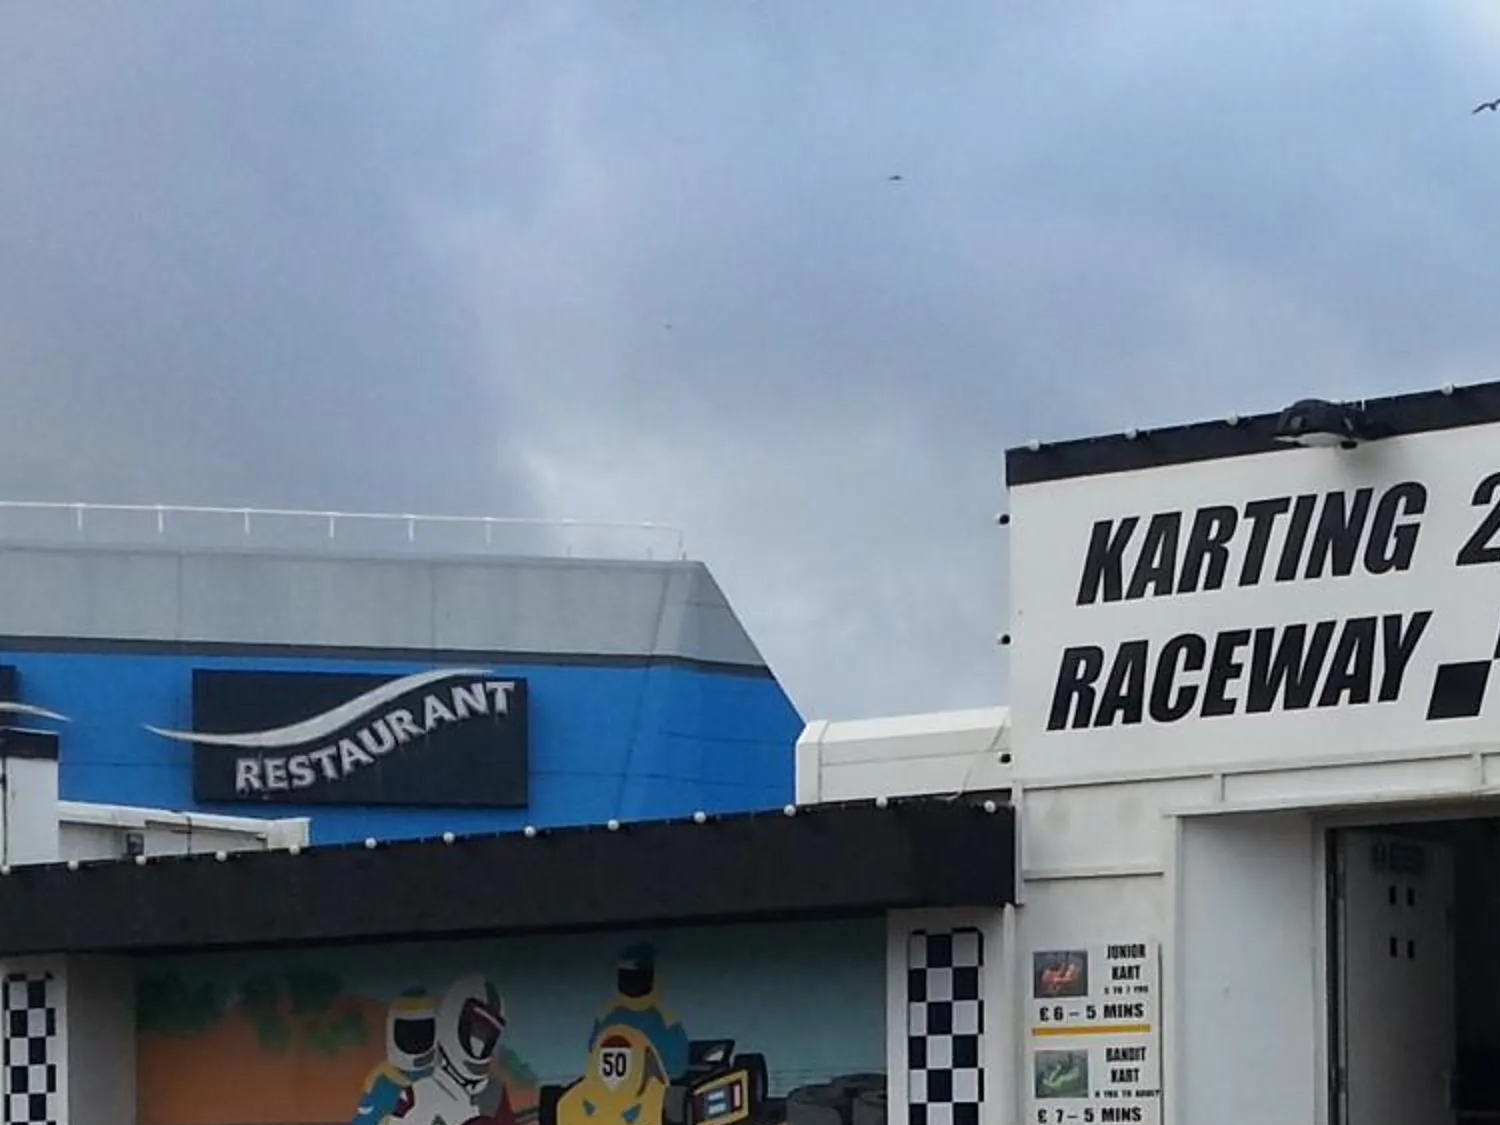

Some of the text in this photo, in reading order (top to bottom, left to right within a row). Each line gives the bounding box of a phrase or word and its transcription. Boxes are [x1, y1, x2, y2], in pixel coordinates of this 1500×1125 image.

[1075, 480, 1428, 606] KARTING
[1046, 610, 1432, 732] RACEWAY
[235, 681, 515, 792] RESTAURANT
[1107, 944, 1146, 959] JUNIOR
[1112, 966, 1140, 980] KART
[1104, 1003, 1144, 1018] MINS
[1106, 1047, 1146, 1062] BANDIT
[601, 1053, 627, 1077] 50
[1111, 1068, 1139, 1082] KART
[1102, 1107, 1142, 1122] MINS
